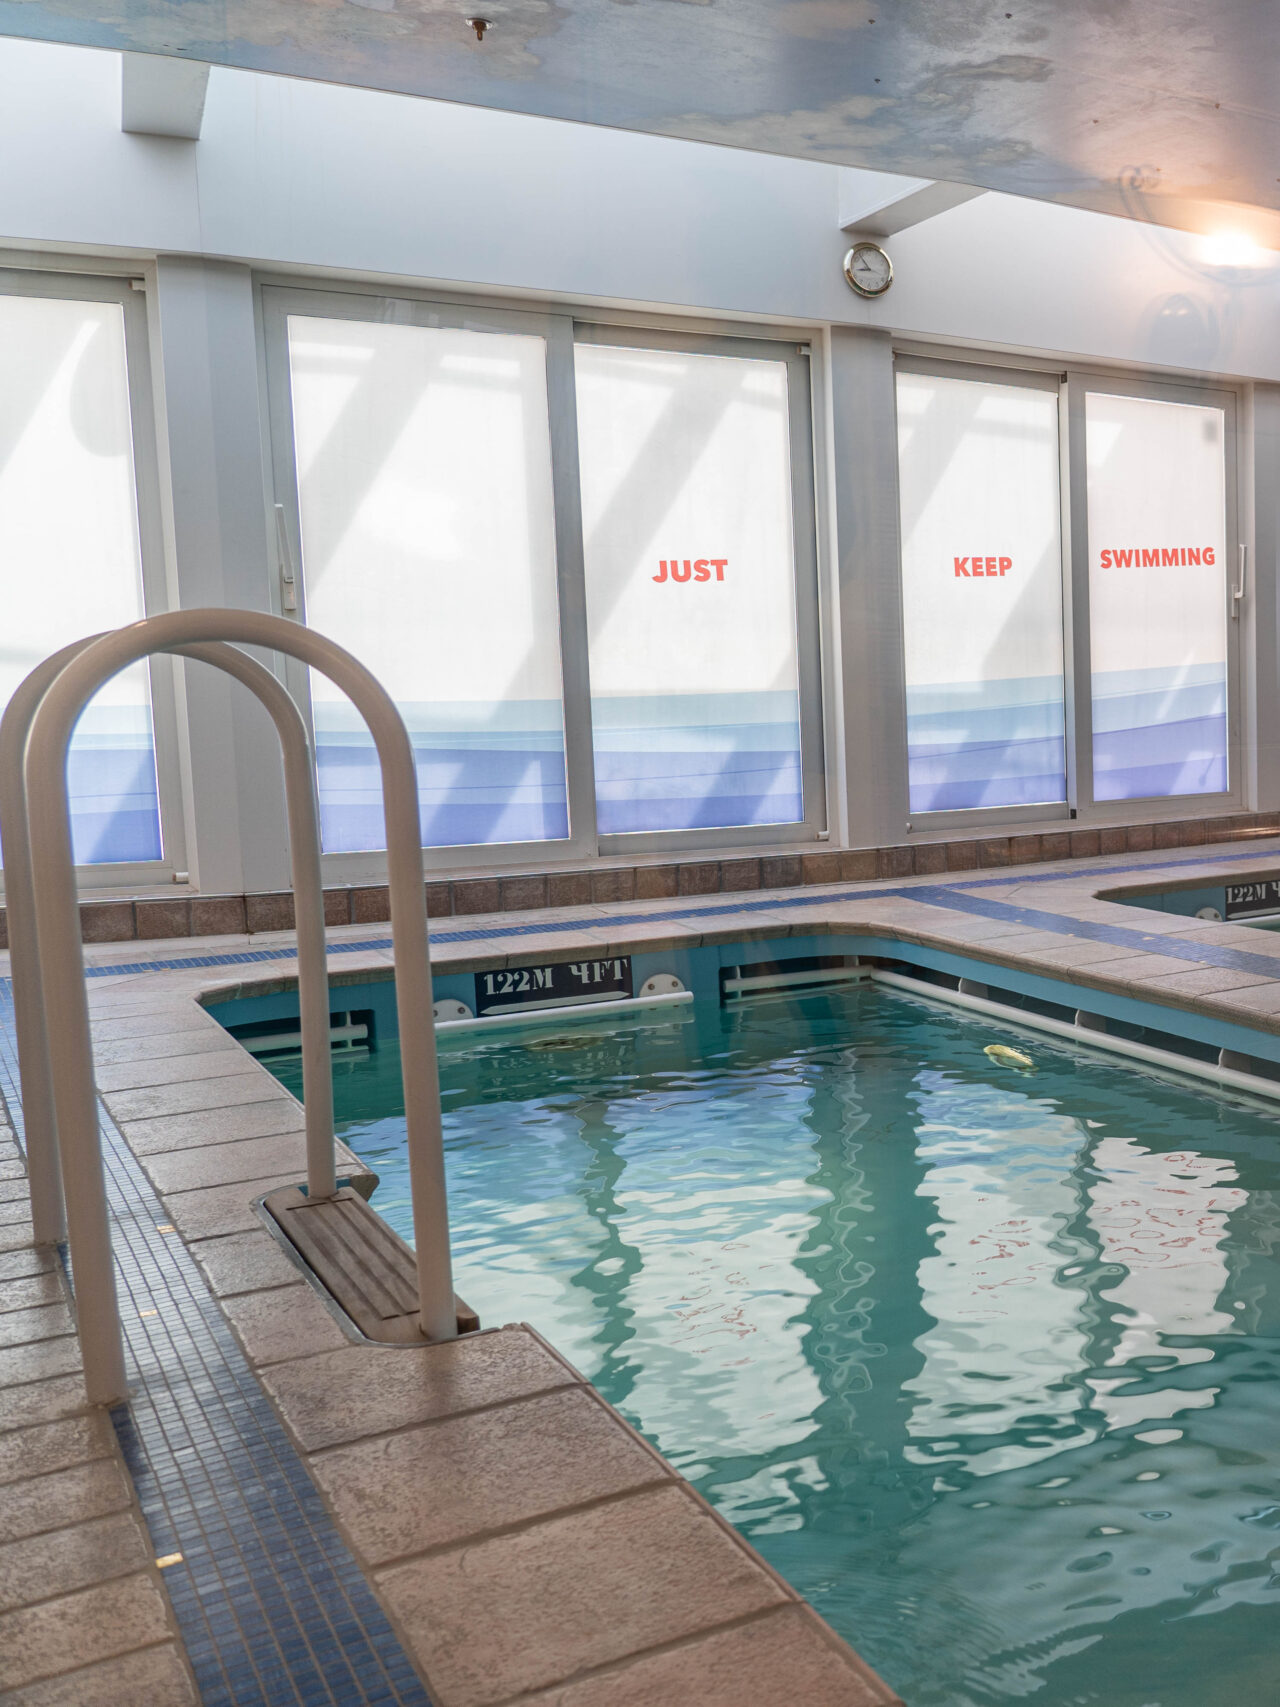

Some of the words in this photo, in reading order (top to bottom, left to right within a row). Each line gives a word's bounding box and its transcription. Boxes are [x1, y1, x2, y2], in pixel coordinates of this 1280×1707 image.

[652, 559, 729, 583] JUST
[953, 556, 1013, 578] KEEP
[1099, 546, 1216, 570] SWIMMING
[568, 958, 628, 985] 4FT
